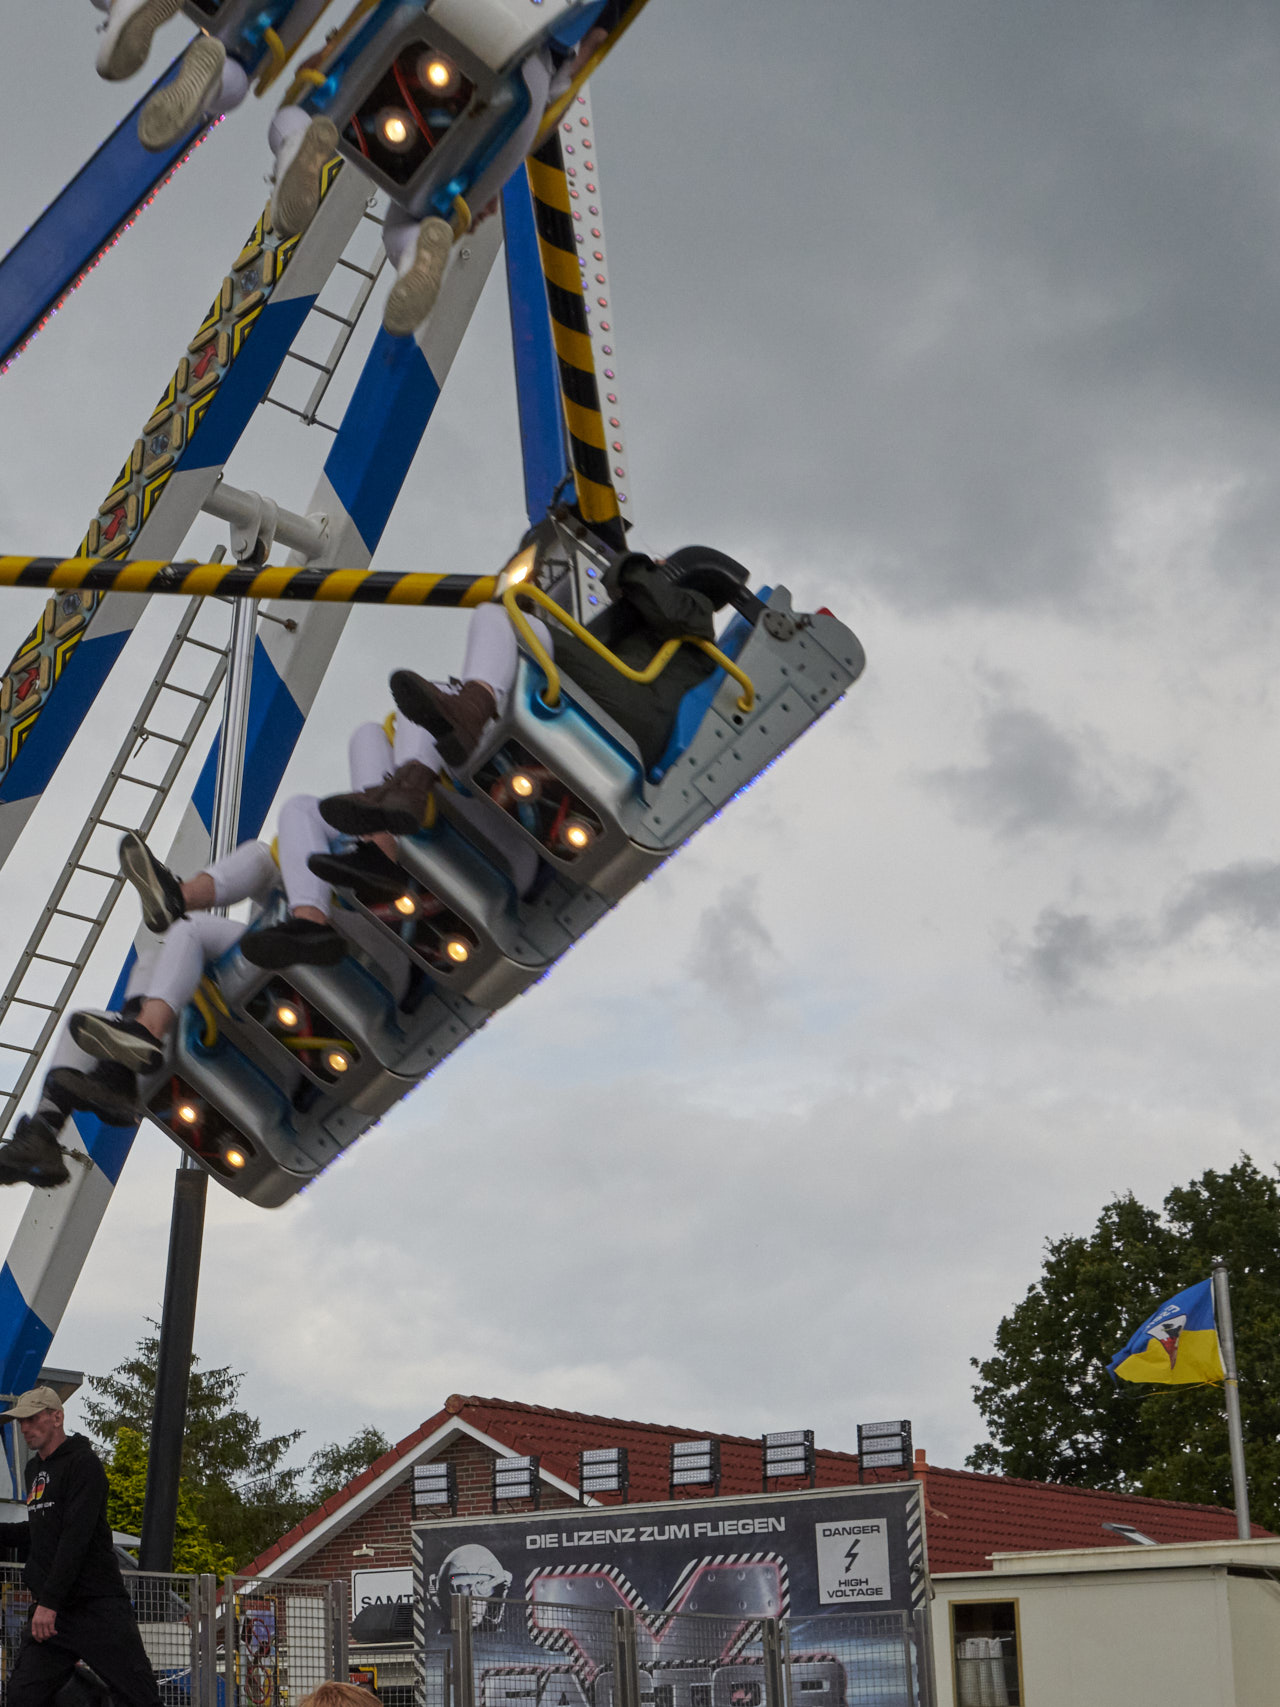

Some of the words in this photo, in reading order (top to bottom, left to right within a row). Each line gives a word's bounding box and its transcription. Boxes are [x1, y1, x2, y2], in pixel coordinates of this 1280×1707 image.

[525, 1533, 559, 1550] DIE
[562, 1527, 636, 1547] LIZENZ
[639, 1523, 690, 1542] ZUM
[694, 1516, 786, 1538] FLIEGEN
[822, 1524, 880, 1538] DANGER
[838, 1578, 869, 1588] HIGH
[826, 1587, 884, 1599] VOLTAGE
